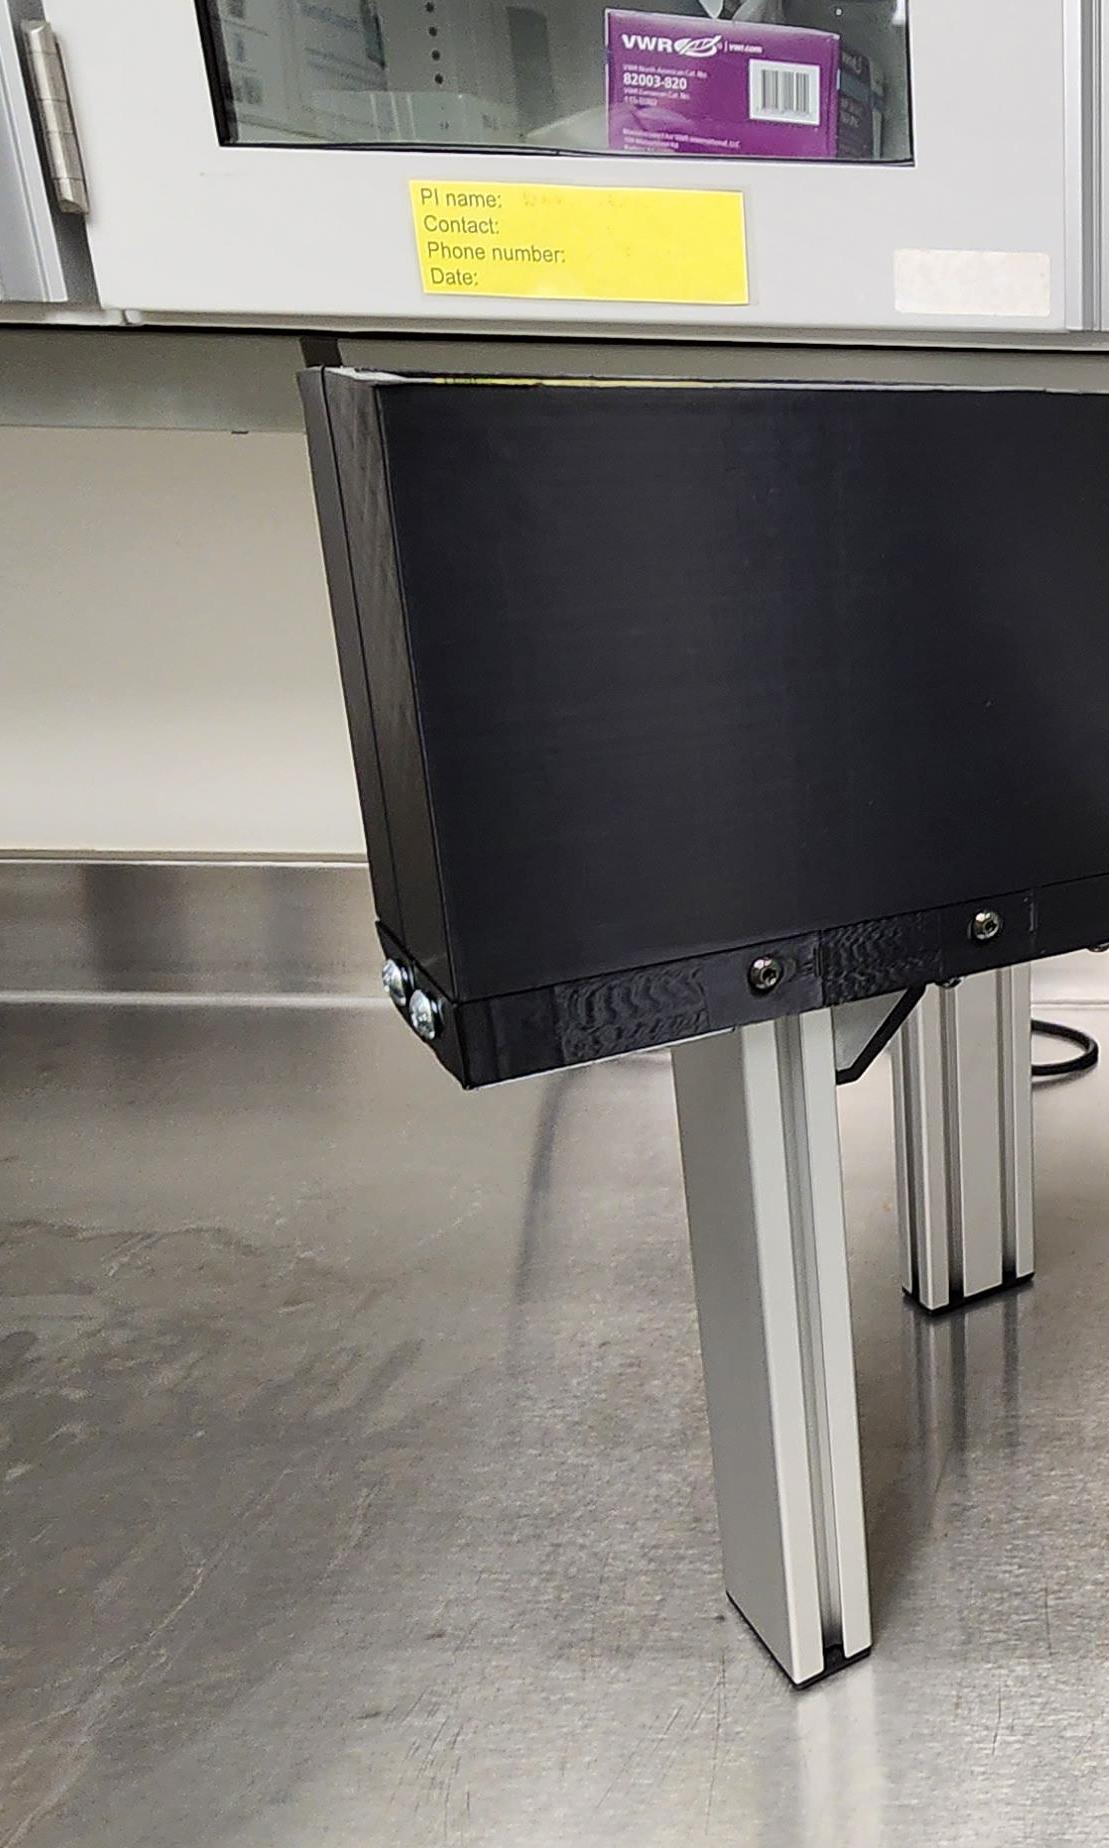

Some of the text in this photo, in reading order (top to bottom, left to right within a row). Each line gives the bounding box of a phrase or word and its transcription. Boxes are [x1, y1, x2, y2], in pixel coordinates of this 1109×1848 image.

[621, 33, 673, 53] VWR
[623, 72, 687, 91] 82003-820
[420, 187, 439, 206] PI
[446, 192, 503, 209] name:
[423, 214, 500, 235] Contact:
[427, 240, 566, 264] Phone number:
[430, 266, 479, 287] Date:
